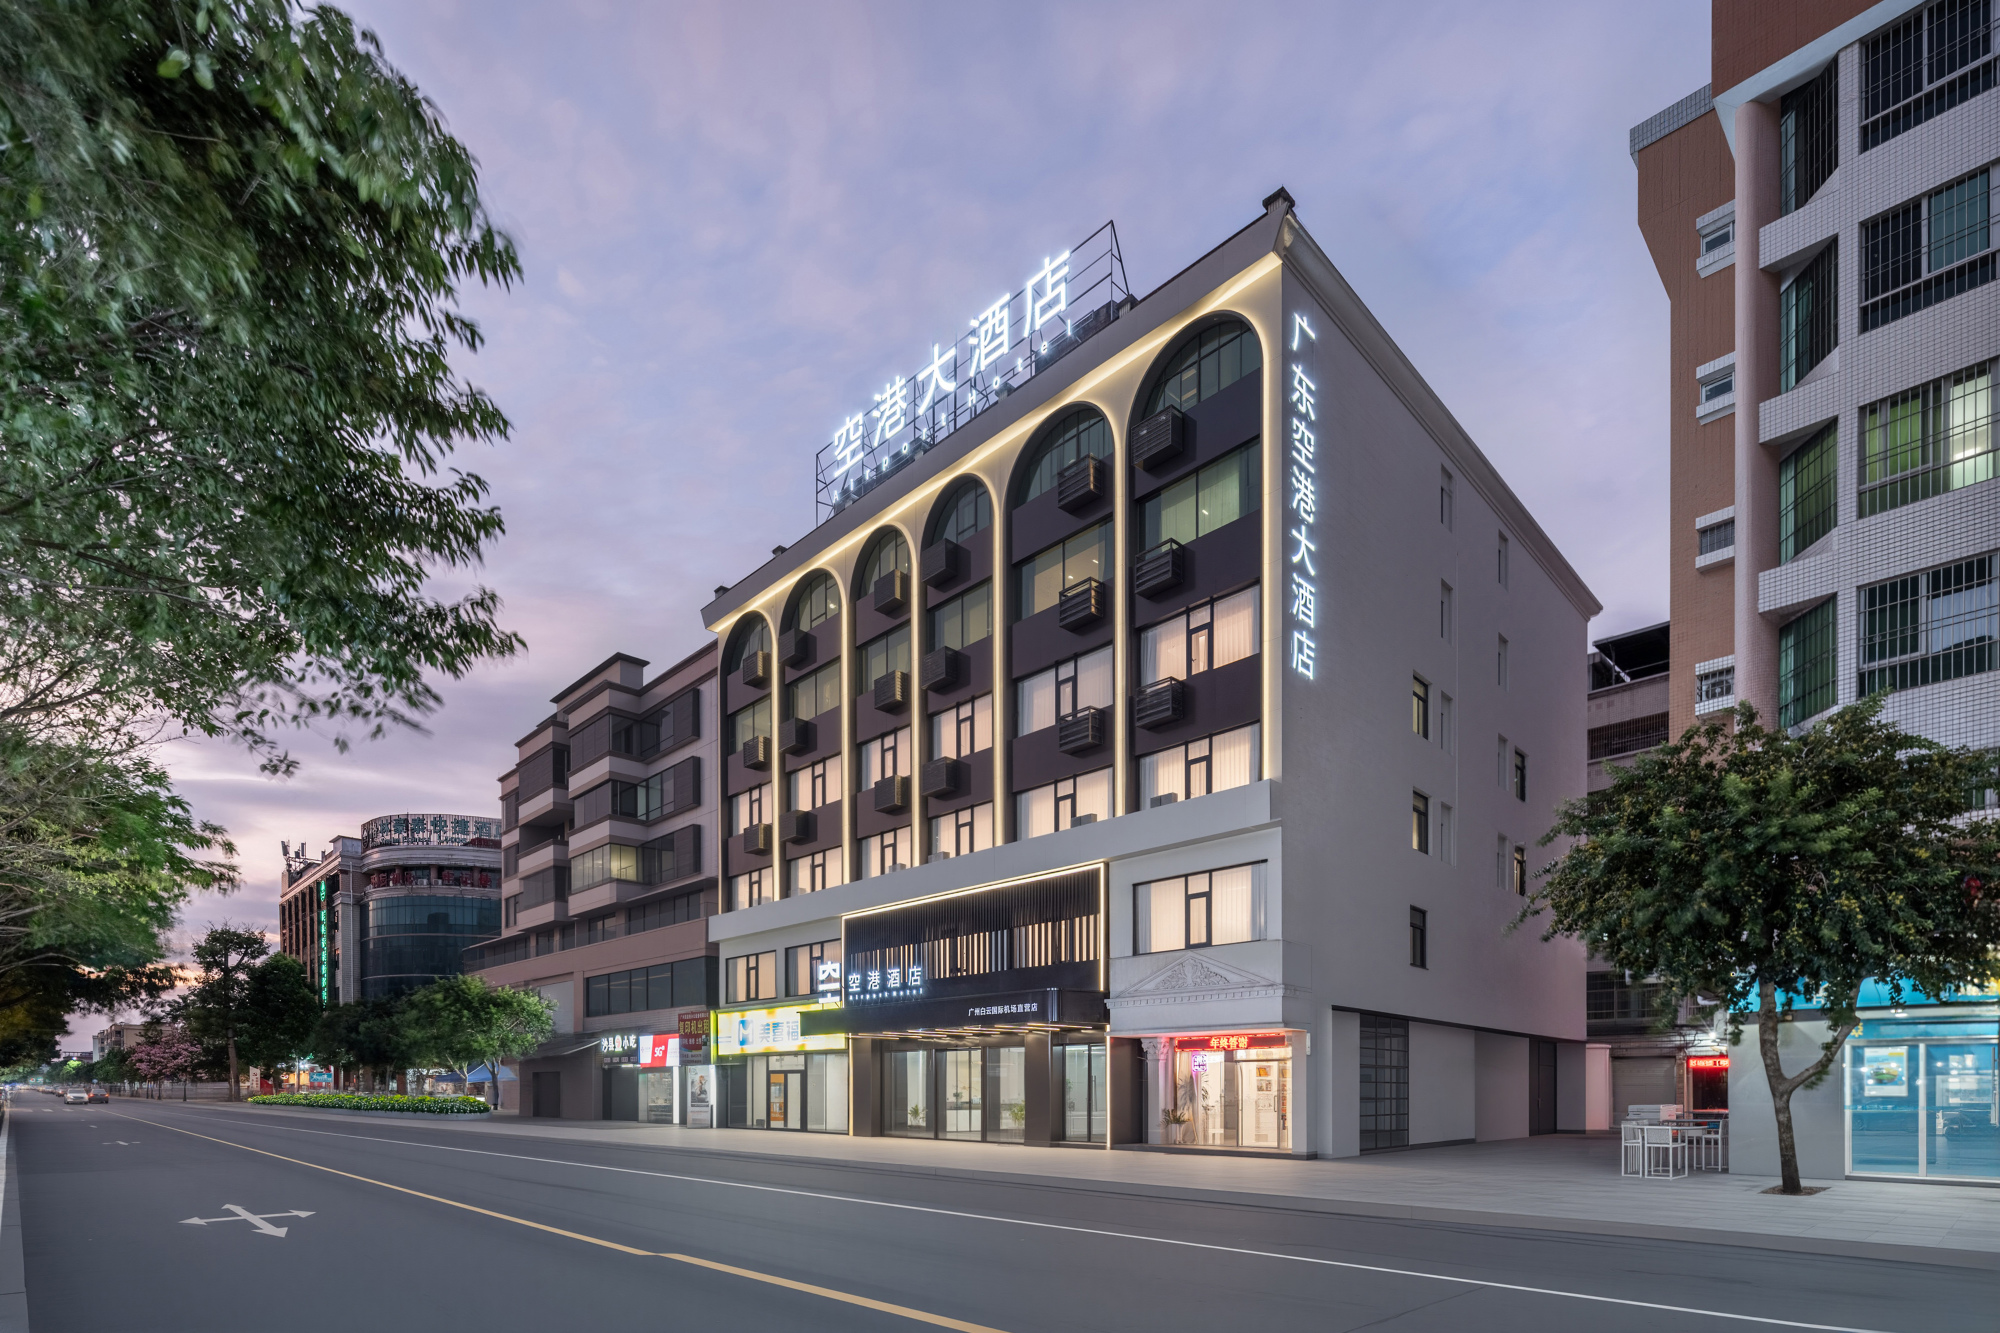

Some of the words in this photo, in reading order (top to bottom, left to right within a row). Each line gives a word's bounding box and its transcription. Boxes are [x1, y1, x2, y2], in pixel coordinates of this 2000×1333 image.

[834, 250, 1070, 478] 空港大酒店
[833, 412, 947, 503] Airport
[968, 318, 1071, 408] Hotel
[1291, 312, 1316, 680] 广东空港大酒店
[848, 965, 922, 992] 空港酒店
[968, 1002, 1038, 1017] 广州白云国际机场直营店
[678, 1019, 710, 1035] 复印机出租
[759, 1020, 800, 1043] 美喜福
